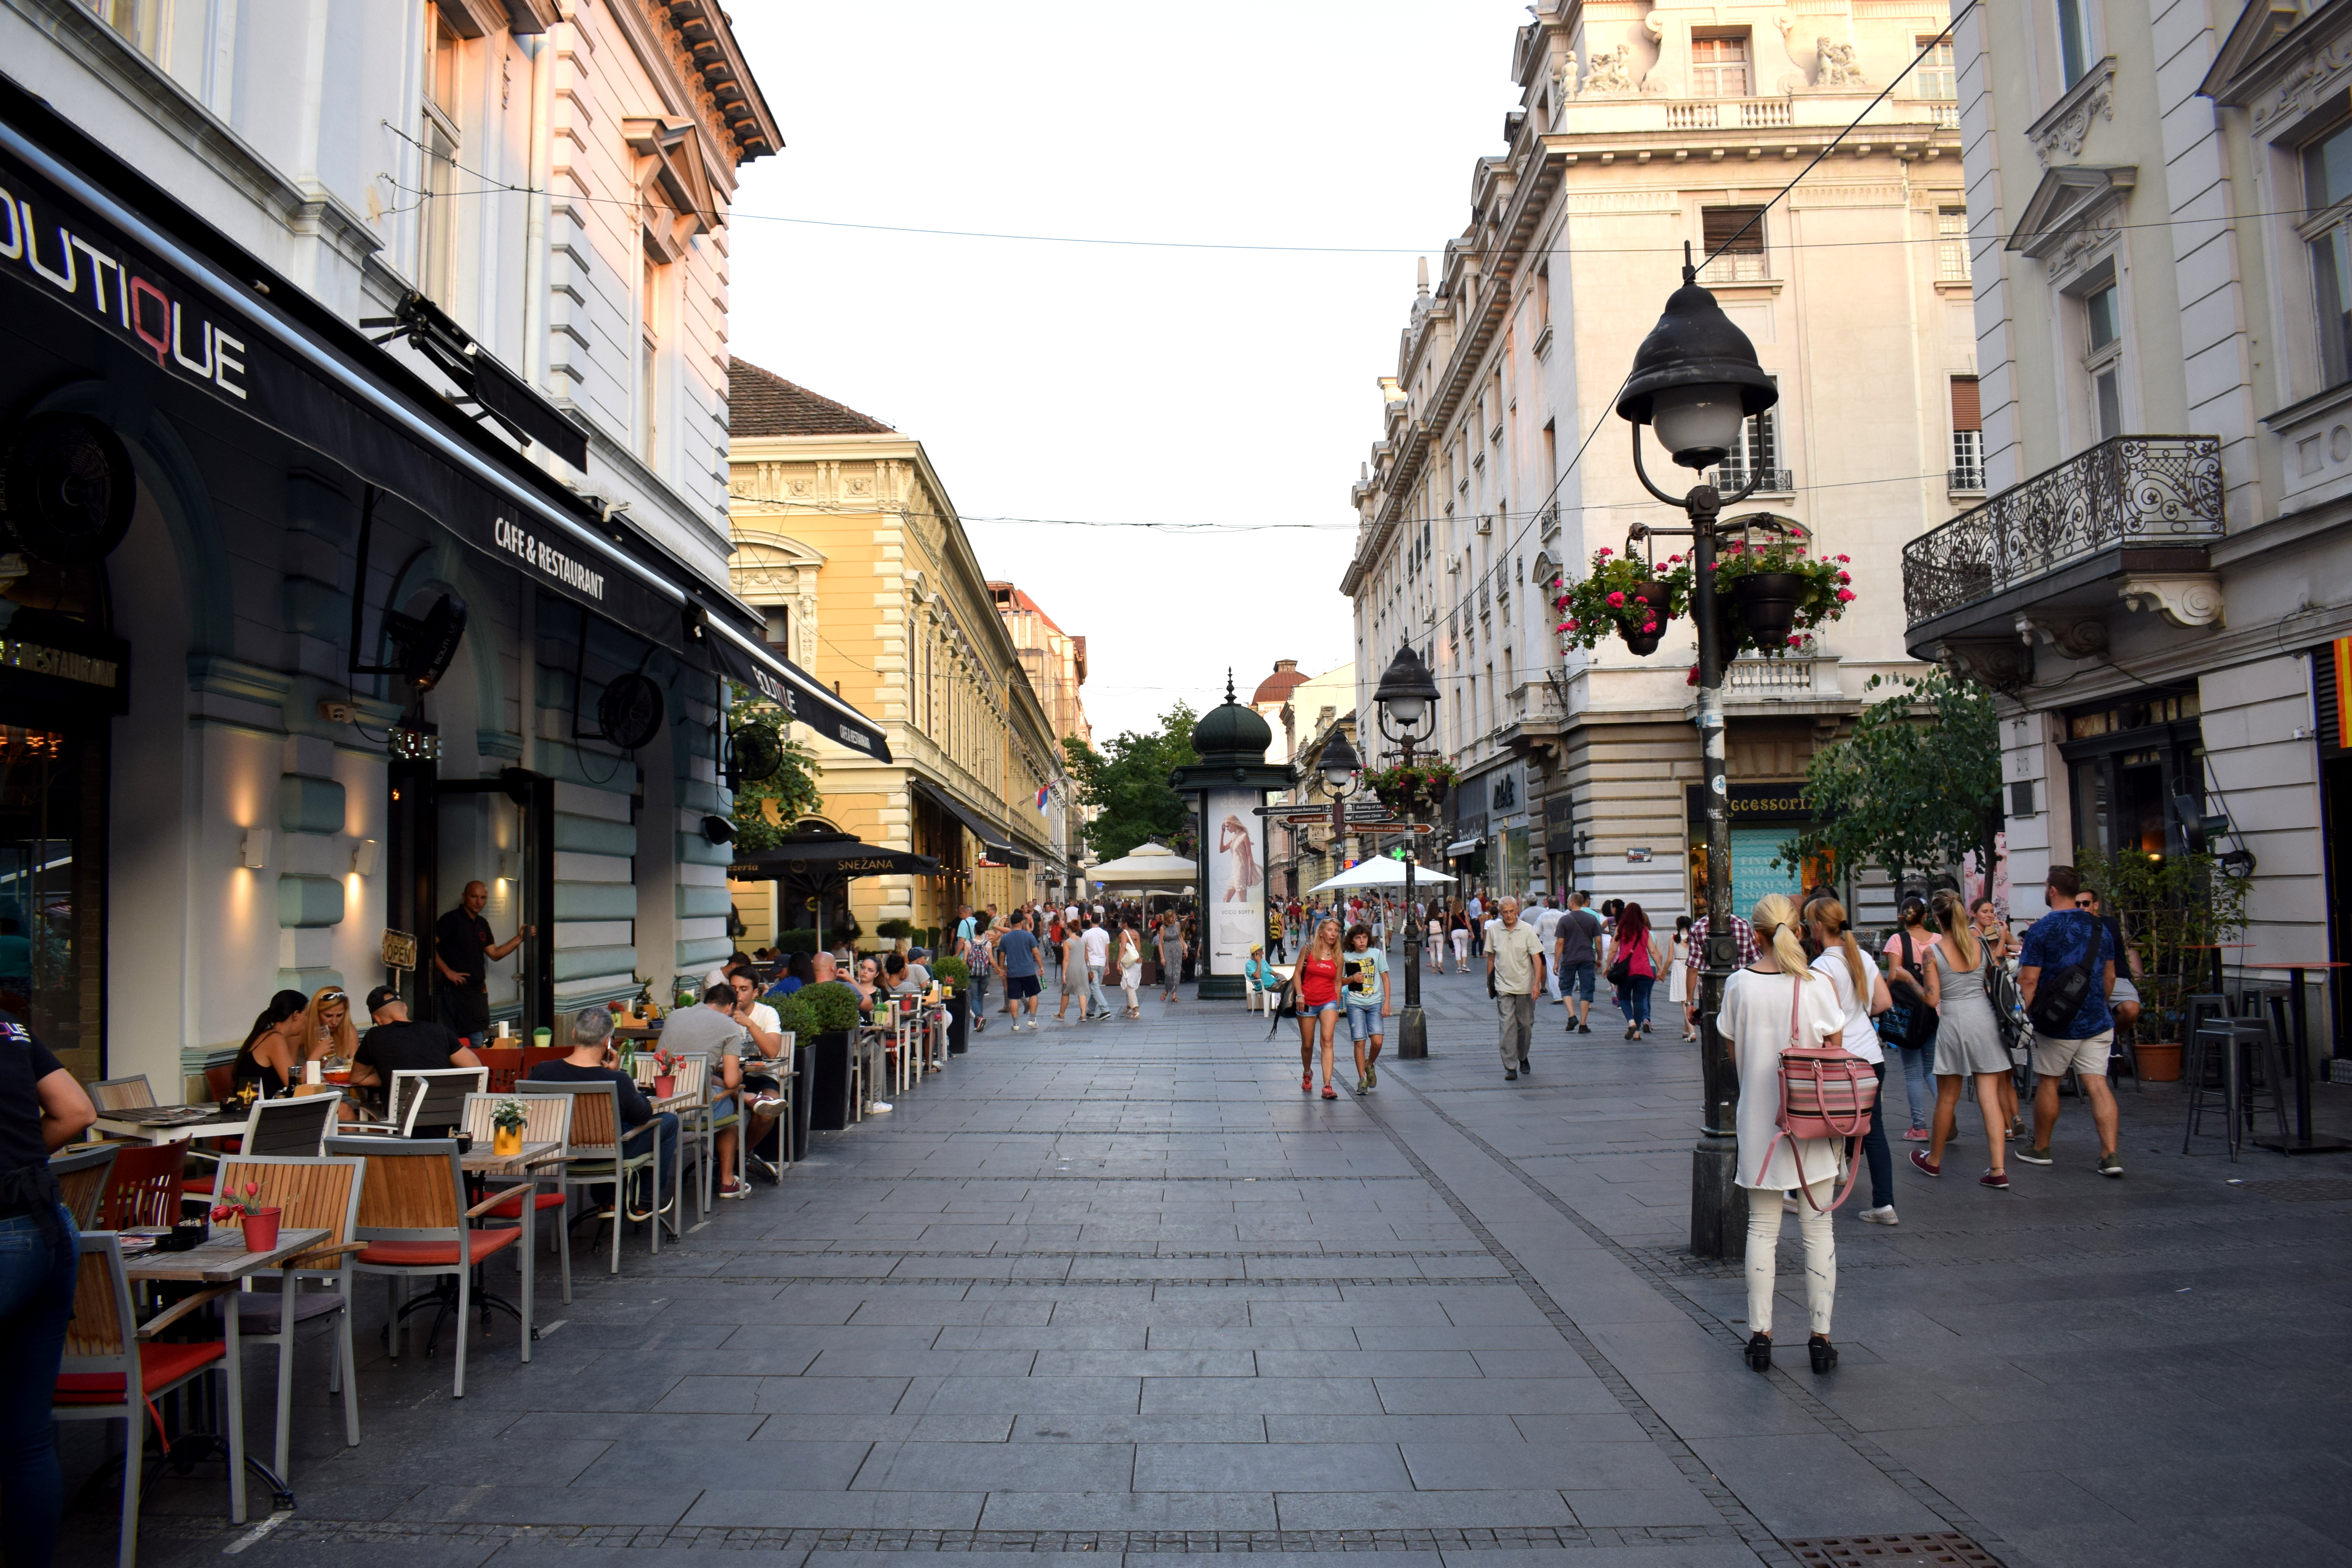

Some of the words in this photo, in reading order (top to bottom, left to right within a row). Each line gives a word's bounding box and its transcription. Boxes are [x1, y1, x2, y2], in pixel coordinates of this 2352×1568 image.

[495, 517, 525, 559] CAFE
[526, 535, 536, 565] &
[538, 541, 604, 601] RESTAURANT
[20, 646, 118, 688] RESTAURANT
[751, 665, 797, 714] BOUTIQUE
[840, 724, 848, 740] CAFE
[850, 730, 871, 750] RESTAURANT
[727, 862, 759, 871] zzeria
[837, 858, 894, 871] SNEŽANA
[1742, 880, 1793, 889] FINALNO
[387, 943, 410, 964] OPEN
[1886, 1012, 1909, 1025] YOUR
[1883, 1022, 1907, 1034] SELF
